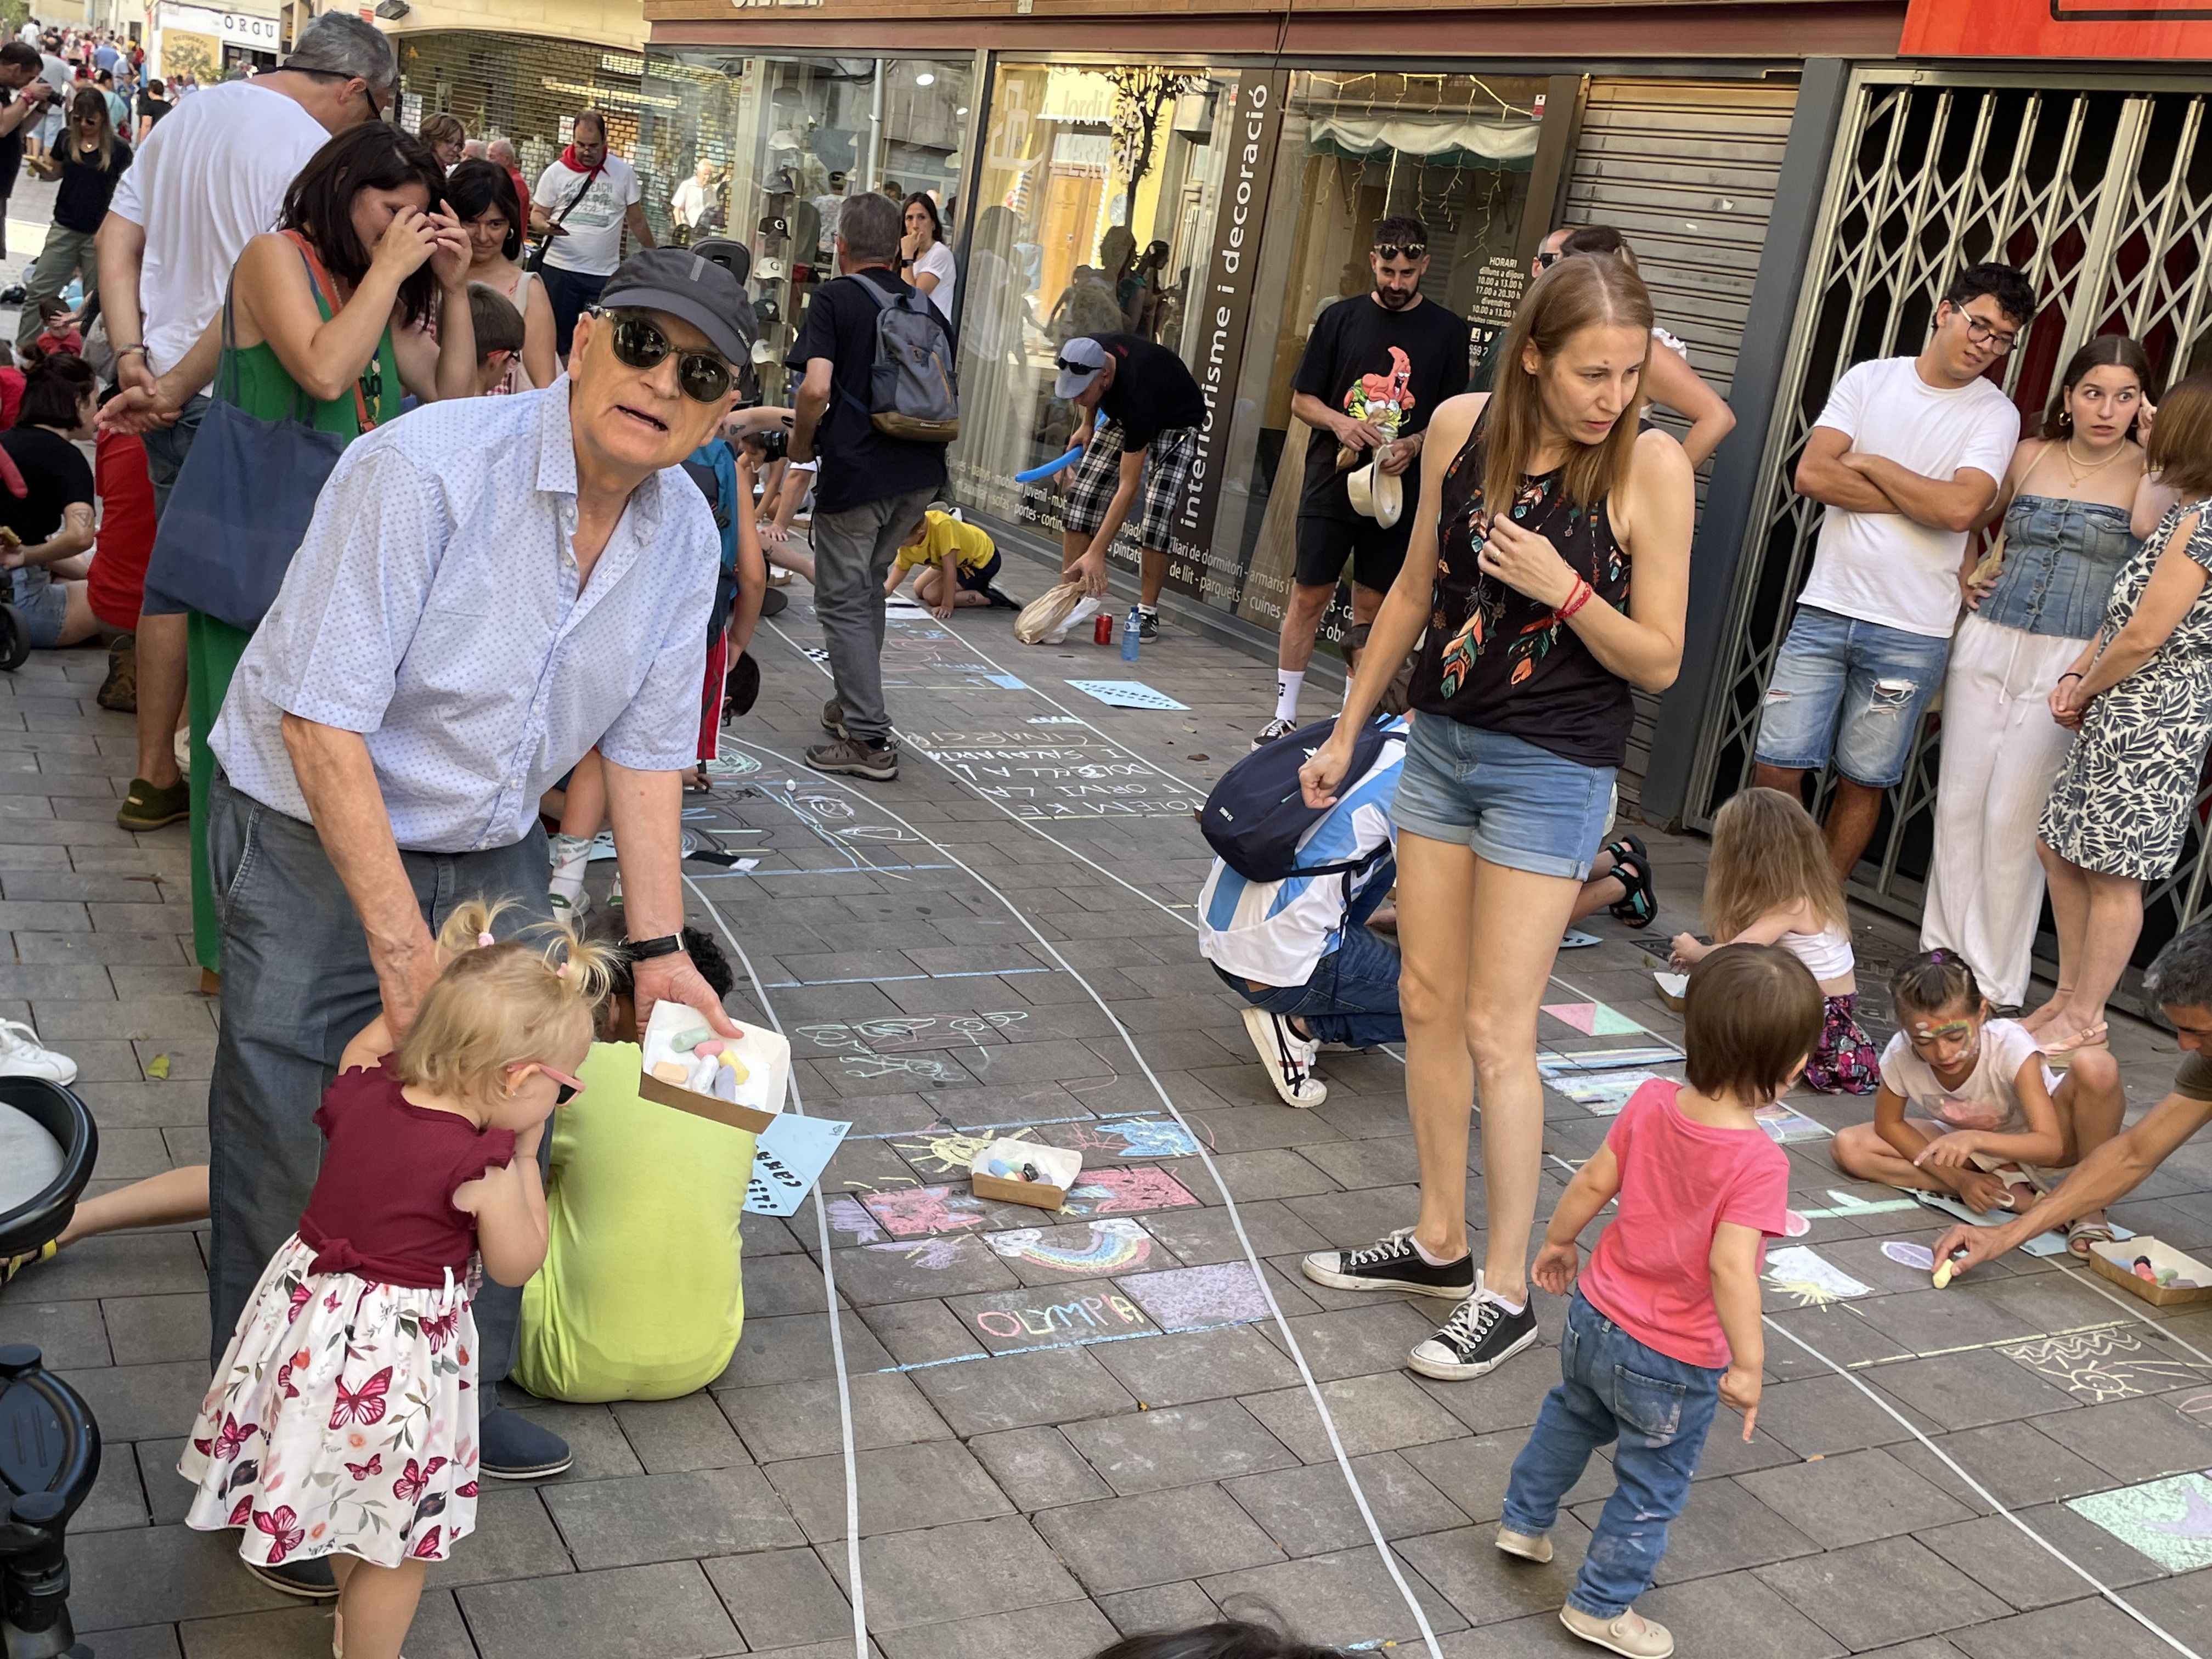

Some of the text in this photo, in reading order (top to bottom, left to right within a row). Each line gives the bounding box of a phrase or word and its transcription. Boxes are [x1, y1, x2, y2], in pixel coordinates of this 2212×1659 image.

[1057, 90, 1103, 126] Jordi
[1489, 257, 1517, 268] HORARI
[1180, 84, 1268, 529] interiorisme i decoració
[1014, 503, 1036, 522] portes
[1113, 540, 1142, 565] pintats
[1169, 561, 1181, 579] de
[1182, 564, 1194, 585] llit
[1199, 575, 1241, 603] parquets
[1250, 595, 1281, 619] cuines
[1023, 484, 1047, 503] juvenil
[1189, 544, 1200, 562] de
[1201, 549, 1244, 578] dormitori
[1249, 568, 1285, 594] armaris
[977, 1294, 1144, 1337] OLYMPIA
